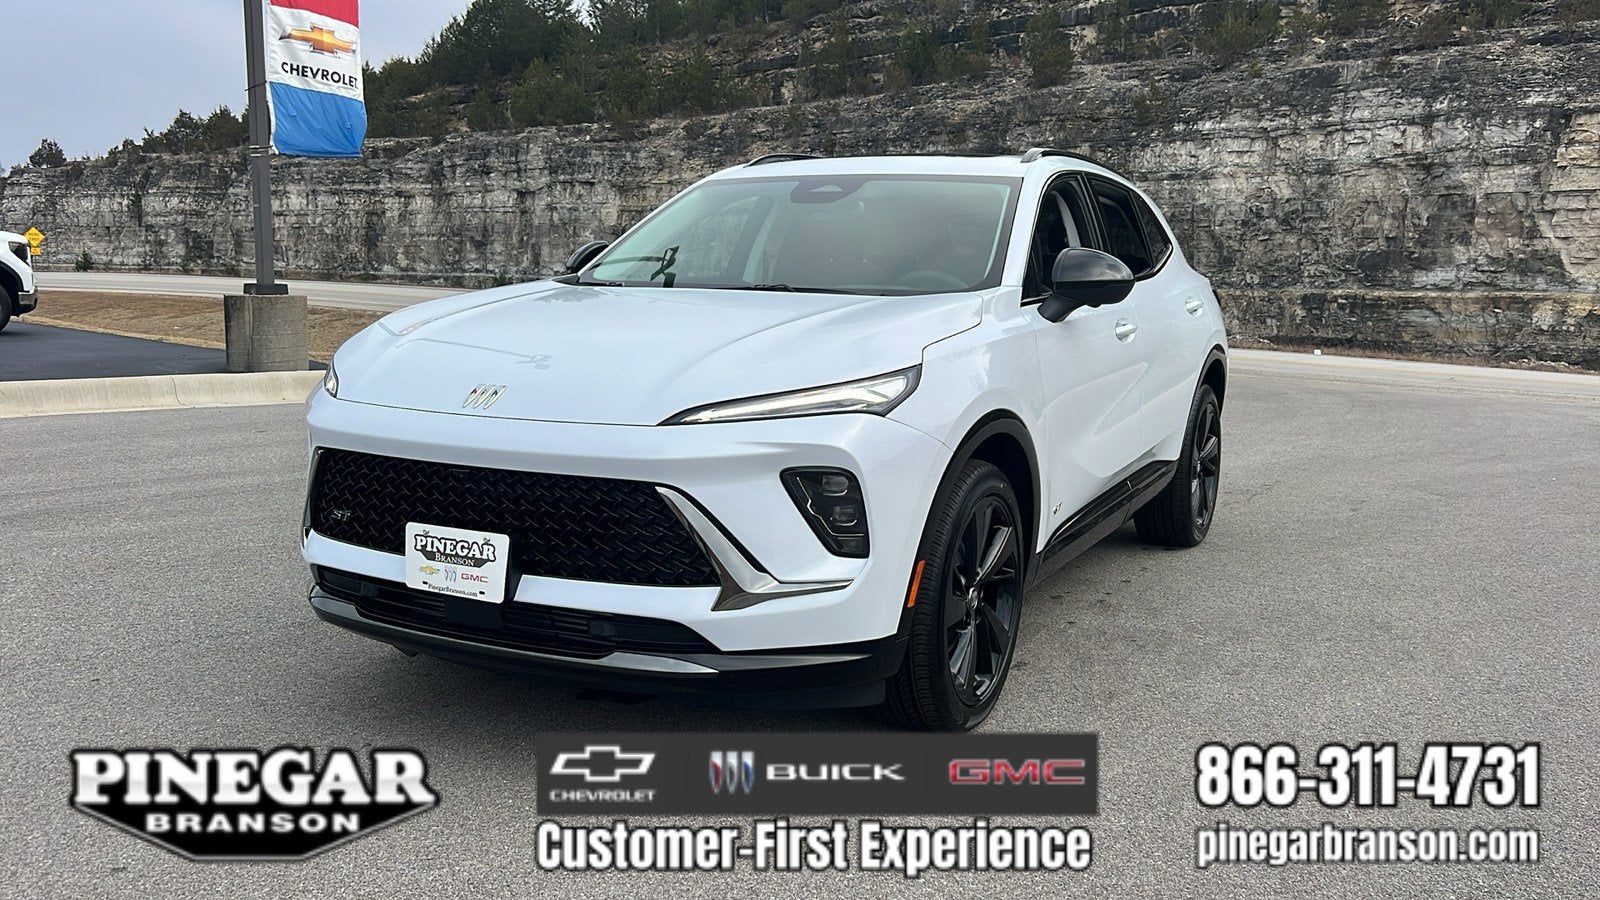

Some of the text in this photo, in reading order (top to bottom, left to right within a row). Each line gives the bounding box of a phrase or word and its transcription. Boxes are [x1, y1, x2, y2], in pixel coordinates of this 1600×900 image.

[281, 61, 358, 88] CHEVROLET
[414, 534, 496, 562] PINEGAR
[435, 552, 475, 566] BRANSON
[461, 573, 488, 583] GMC
